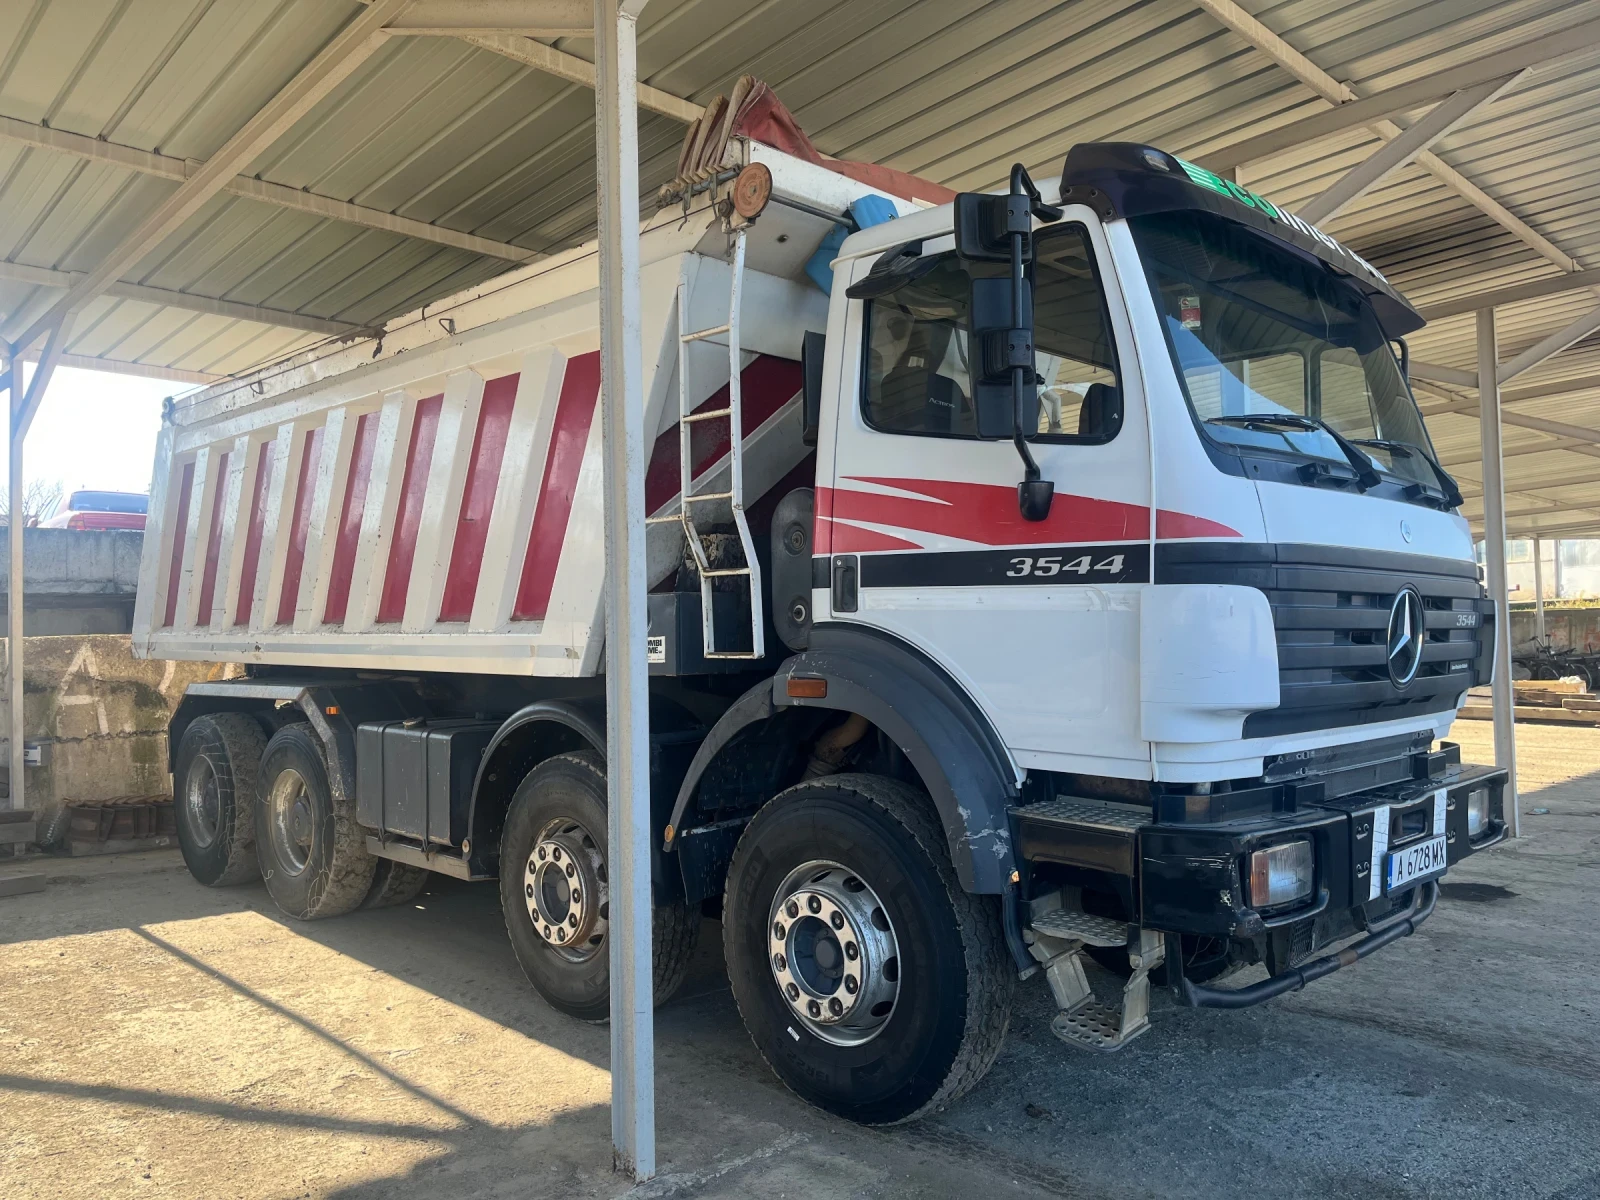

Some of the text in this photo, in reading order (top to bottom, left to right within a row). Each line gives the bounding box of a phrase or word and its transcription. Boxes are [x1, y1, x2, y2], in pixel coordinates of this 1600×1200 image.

[1006, 554, 1125, 577] 3544
[1456, 614, 1476, 627] 3544
[1397, 839, 1445, 882] A 6728 MX
